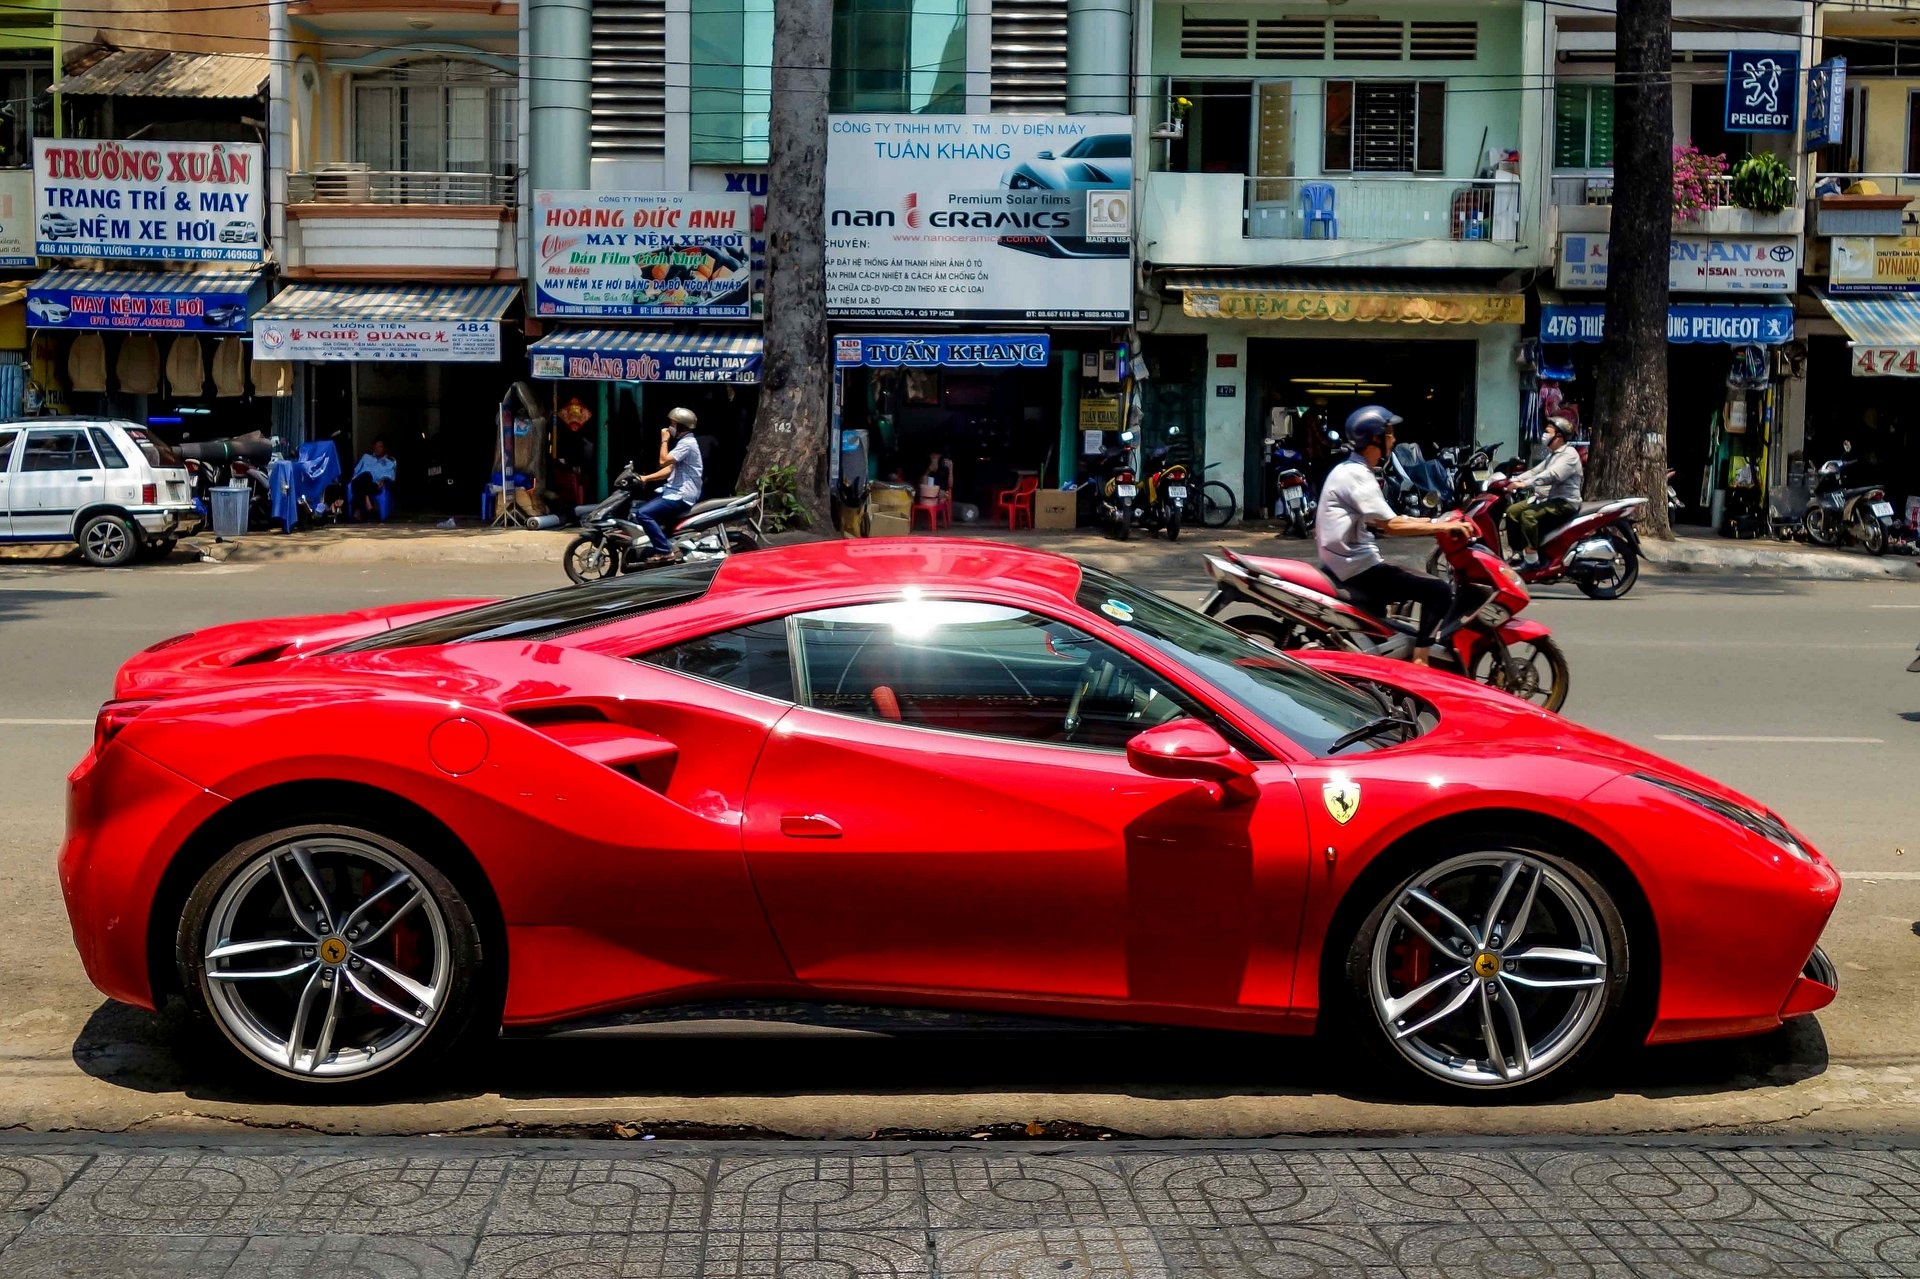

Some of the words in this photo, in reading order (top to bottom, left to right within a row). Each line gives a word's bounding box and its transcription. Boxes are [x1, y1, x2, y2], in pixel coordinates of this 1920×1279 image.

[1731, 113, 1789, 125] PEUGEOT
[832, 121, 871, 134] CÔNG
[875, 122, 890, 134] TY
[895, 123, 930, 134] TNHH
[934, 123, 962, 134] MTV
[972, 123, 991, 134] TM
[1002, 124, 1020, 135] DV
[1023, 121, 1054, 136] ĐIỆN
[1058, 122, 1086, 135] MÁY
[874, 139, 930, 159] TUẤN
[937, 143, 1011, 160] KHANG
[45, 141, 163, 182] TRƯỜNG
[167, 144, 251, 184] XUÂN
[44, 187, 121, 209] TRANG
[128, 186, 166, 210] TRÍ
[174, 191, 191, 211] &
[200, 192, 249, 212] MAY
[948, 194, 1002, 205] Premium
[1007, 194, 1038, 205] Solar
[1041, 194, 1071, 205] films
[546, 205, 625, 228] HOÀNG
[633, 206, 681, 229] ĐỨC
[688, 209, 737, 229] ANH
[1092, 199, 1126, 222] 10
[79, 214, 131, 242] NỆM
[139, 219, 167, 240] XE
[177, 218, 215, 241] HƠI
[587, 234, 628, 246] MAY
[634, 231, 675, 248] NỆM
[680, 234, 704, 246] XE
[710, 233, 743, 247] HƠI
[892, 233, 1048, 244] www.nanoceramics.com.vn
[39, 243, 56, 253] 486
[58, 244, 70, 254] AN
[140, 247, 154, 256] P.4
[162, 248, 176, 258] Q.5
[201, 249, 258, 260] 0907.469688
[570, 250, 597, 265] Dán
[601, 251, 630, 265] Film
[904, 258, 928, 267] THANH
[1877, 257, 1920, 276] DYNAMO
[840, 271, 857, 279] PHIM
[1744, 268, 1785, 278] TOYOTA
[544, 278, 564, 289] MAY
[591, 279, 604, 290] XE
[918, 285, 936, 293] THEO
[71, 295, 105, 314] MAY
[110, 293, 147, 317] NỆM
[150, 299, 172, 316] XE
[176, 297, 204, 316] HƠI
[1228, 294, 1289, 316] TIỆM
[457, 323, 490, 332] 484
[1548, 315, 1577, 337] 476
[1692, 317, 1761, 338] PEUGEOT
[867, 339, 940, 361] TUẤN
[948, 343, 1045, 361] KHANG
[568, 352, 623, 379] HOÀNG
[626, 353, 660, 380] ĐỨC
[674, 354, 720, 368] CHUYÊN
[722, 357, 747, 368] MAY
[1857, 349, 1919, 373] 474
[665, 370, 686, 380] MUI
[689, 369, 715, 383] NỆM
[717, 371, 732, 382] XE
[774, 422, 792, 433] 142
[1646, 431, 1664, 445] 140
